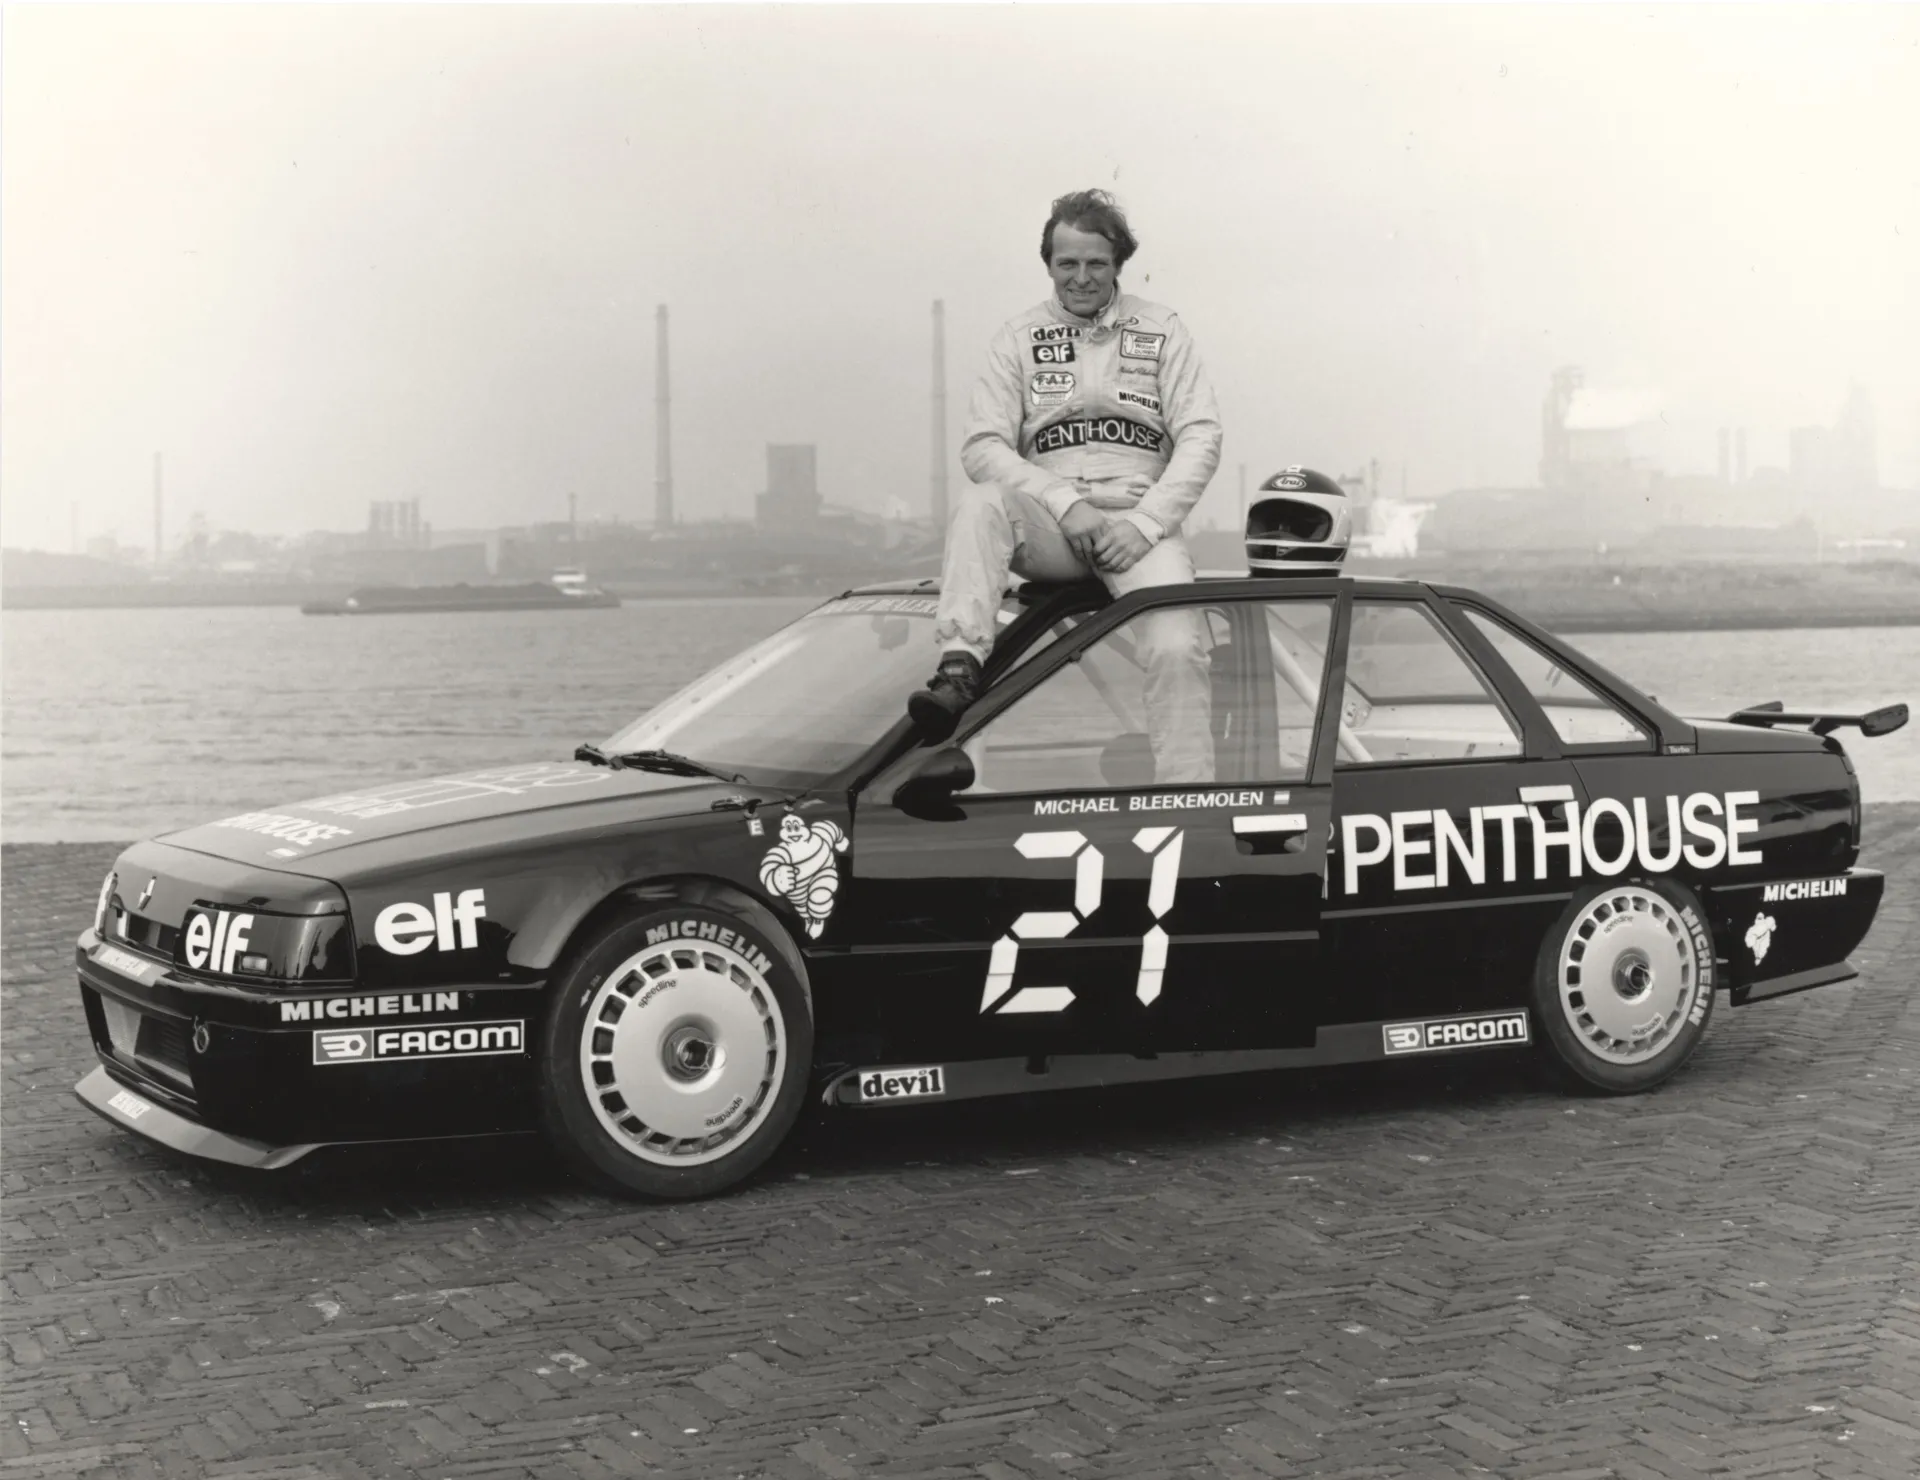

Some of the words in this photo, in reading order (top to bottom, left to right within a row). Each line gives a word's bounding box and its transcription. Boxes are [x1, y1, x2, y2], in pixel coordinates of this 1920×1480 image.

[1037, 343, 1071, 362] elf
[1118, 391, 1160, 412] MICHELIN
[1038, 419, 1161, 450] PENTHOUSE
[1034, 797, 1120, 816] MICHAEL
[1129, 791, 1264, 811] BLEEKEMOLEN
[1341, 790, 1763, 895] PENTHOUSE
[1763, 878, 1847, 902] MICHELIN
[374, 888, 487, 956] elf
[980, 826, 1184, 1015] 21
[185, 911, 255, 974] elf
[645, 919, 773, 976] MICHELIN
[1679, 905, 1712, 1027] MICHELIN
[281, 991, 459, 1022] MICHELIN
[638, 979, 677, 1009] speedline
[378, 1026, 520, 1055] FACOM
[1427, 1017, 1524, 1045] FACOM
[863, 1068, 942, 1098] devil
